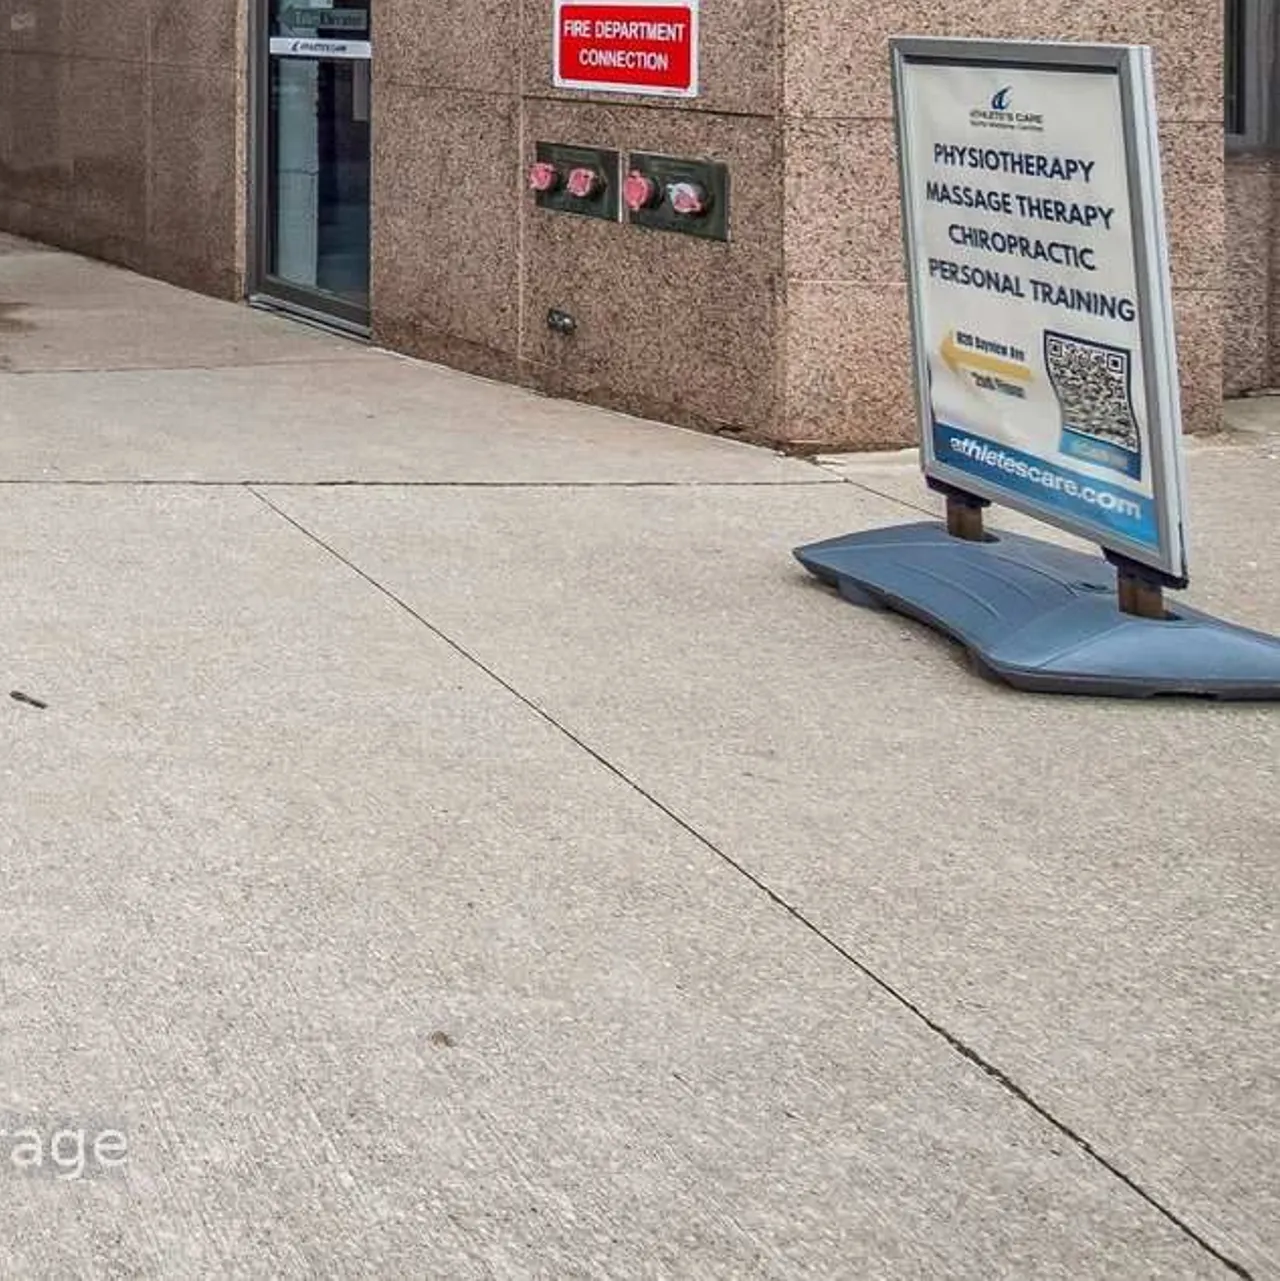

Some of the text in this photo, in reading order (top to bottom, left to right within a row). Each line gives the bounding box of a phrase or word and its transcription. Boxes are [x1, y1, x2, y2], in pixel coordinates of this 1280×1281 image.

[564, 20, 686, 42] FIRE DEPARTMENT
[579, 48, 669, 70] CONNECTION
[934, 143, 1095, 183] PHYSIOTHERAPY
[926, 181, 1114, 230] MASSAGE THERAPY
[948, 224, 1096, 271] CHIROPRACTIC
[929, 258, 1136, 321] PERSONAL TRAINING
[950, 437, 1141, 518] athletescare.com
